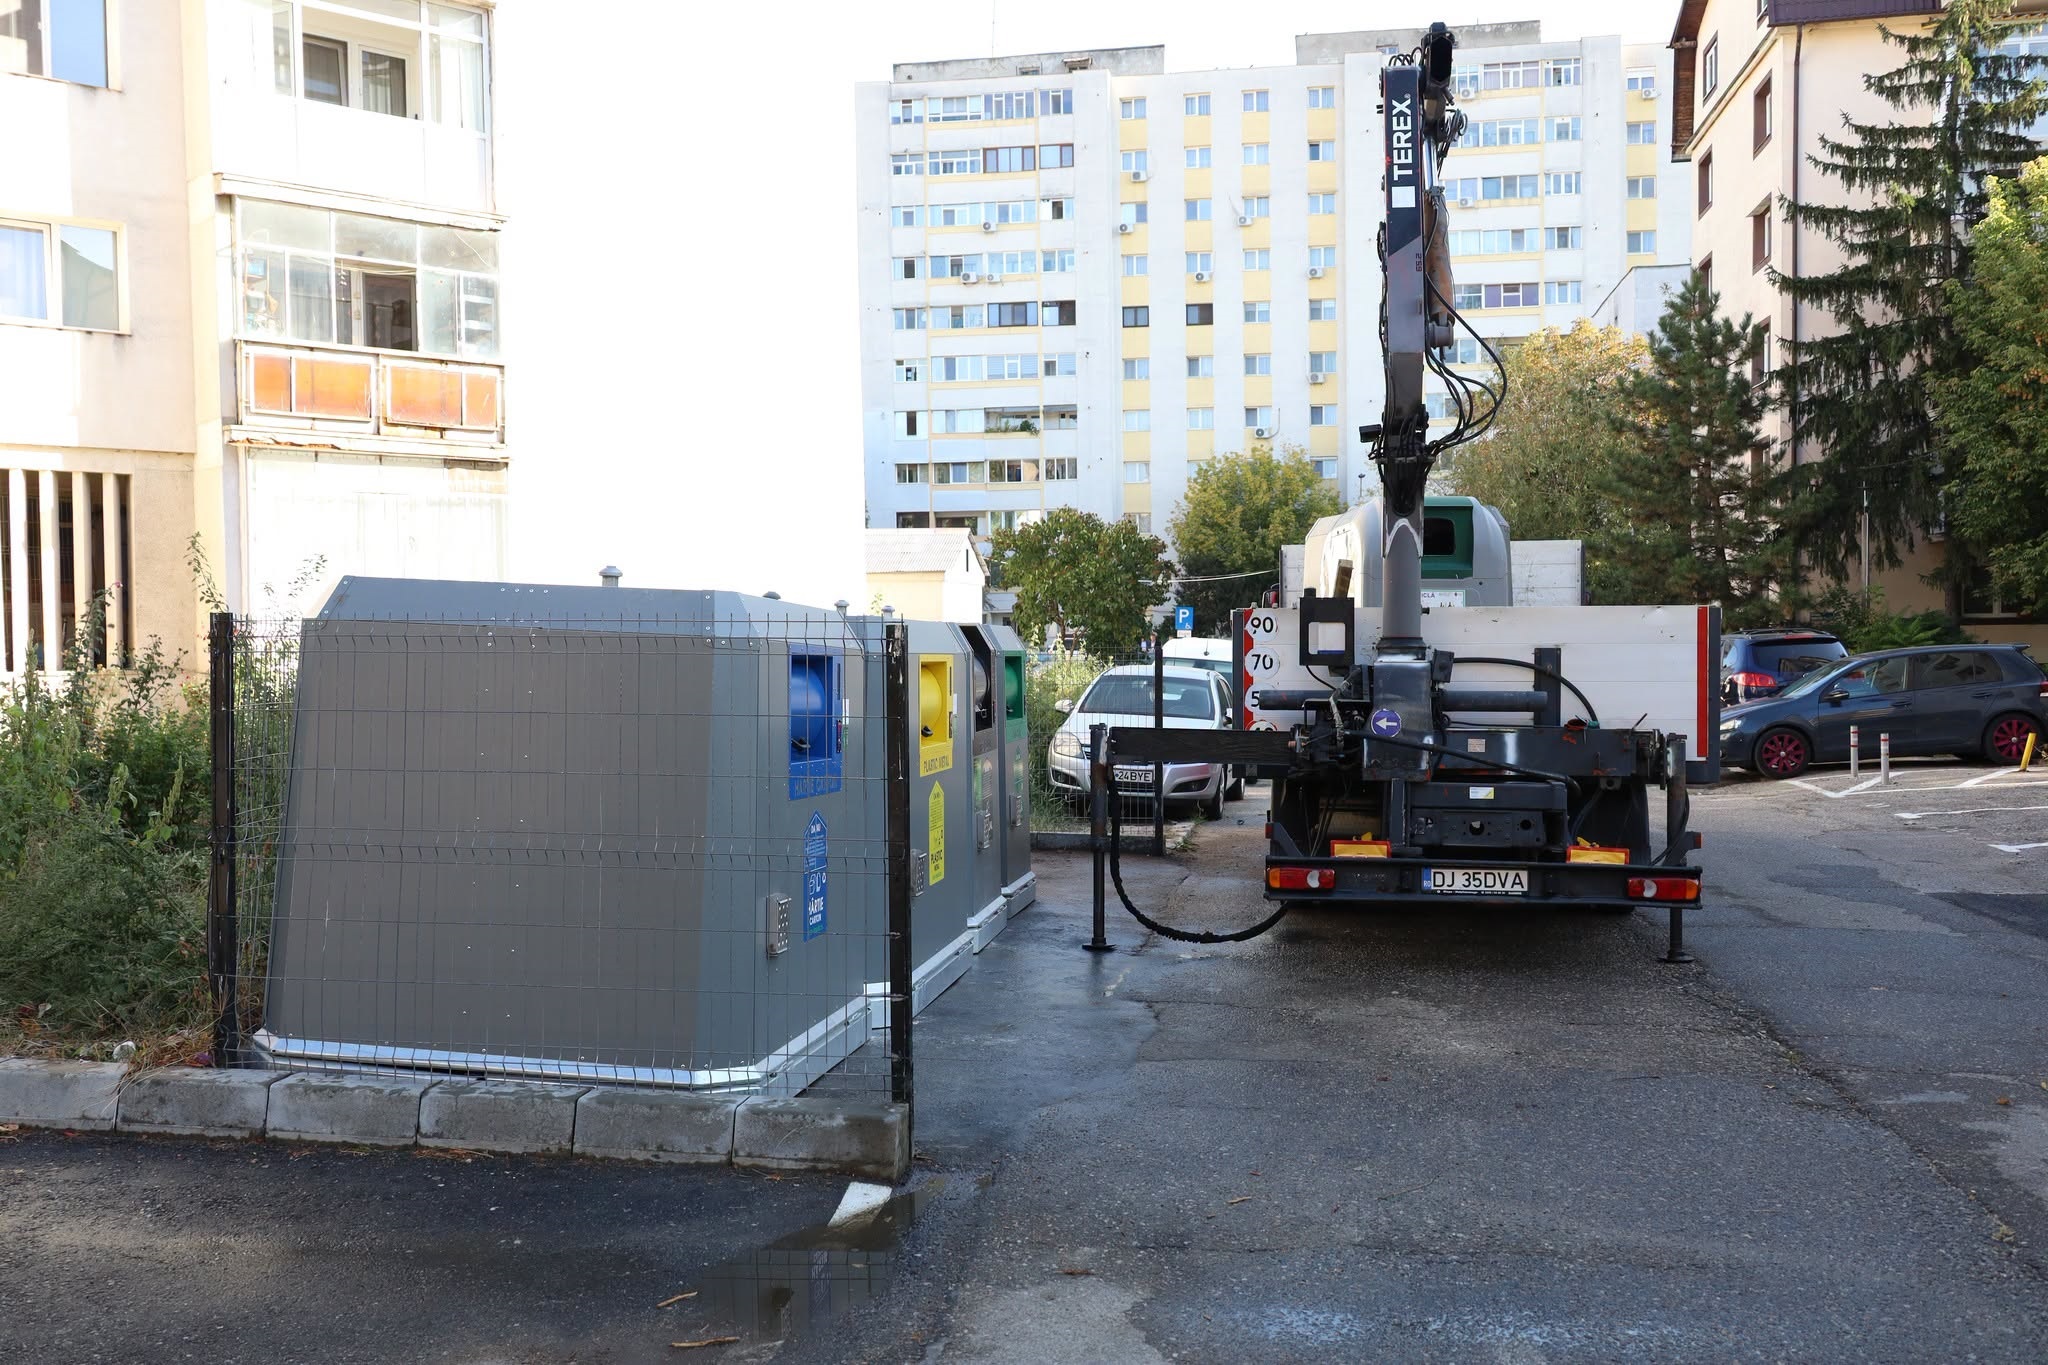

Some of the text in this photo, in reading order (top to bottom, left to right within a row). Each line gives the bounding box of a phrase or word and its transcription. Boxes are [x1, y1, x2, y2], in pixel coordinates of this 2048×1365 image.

[1391, 98, 1413, 181] TEREX
[1179, 609, 1190, 623] P
[1251, 617, 1274, 634] 90
[1251, 654, 1274, 670] 70
[1251, 691, 1260, 707] 5
[1118, 770, 1151, 782] 24BYE
[1433, 871, 1525, 889] DJ 35DVA
